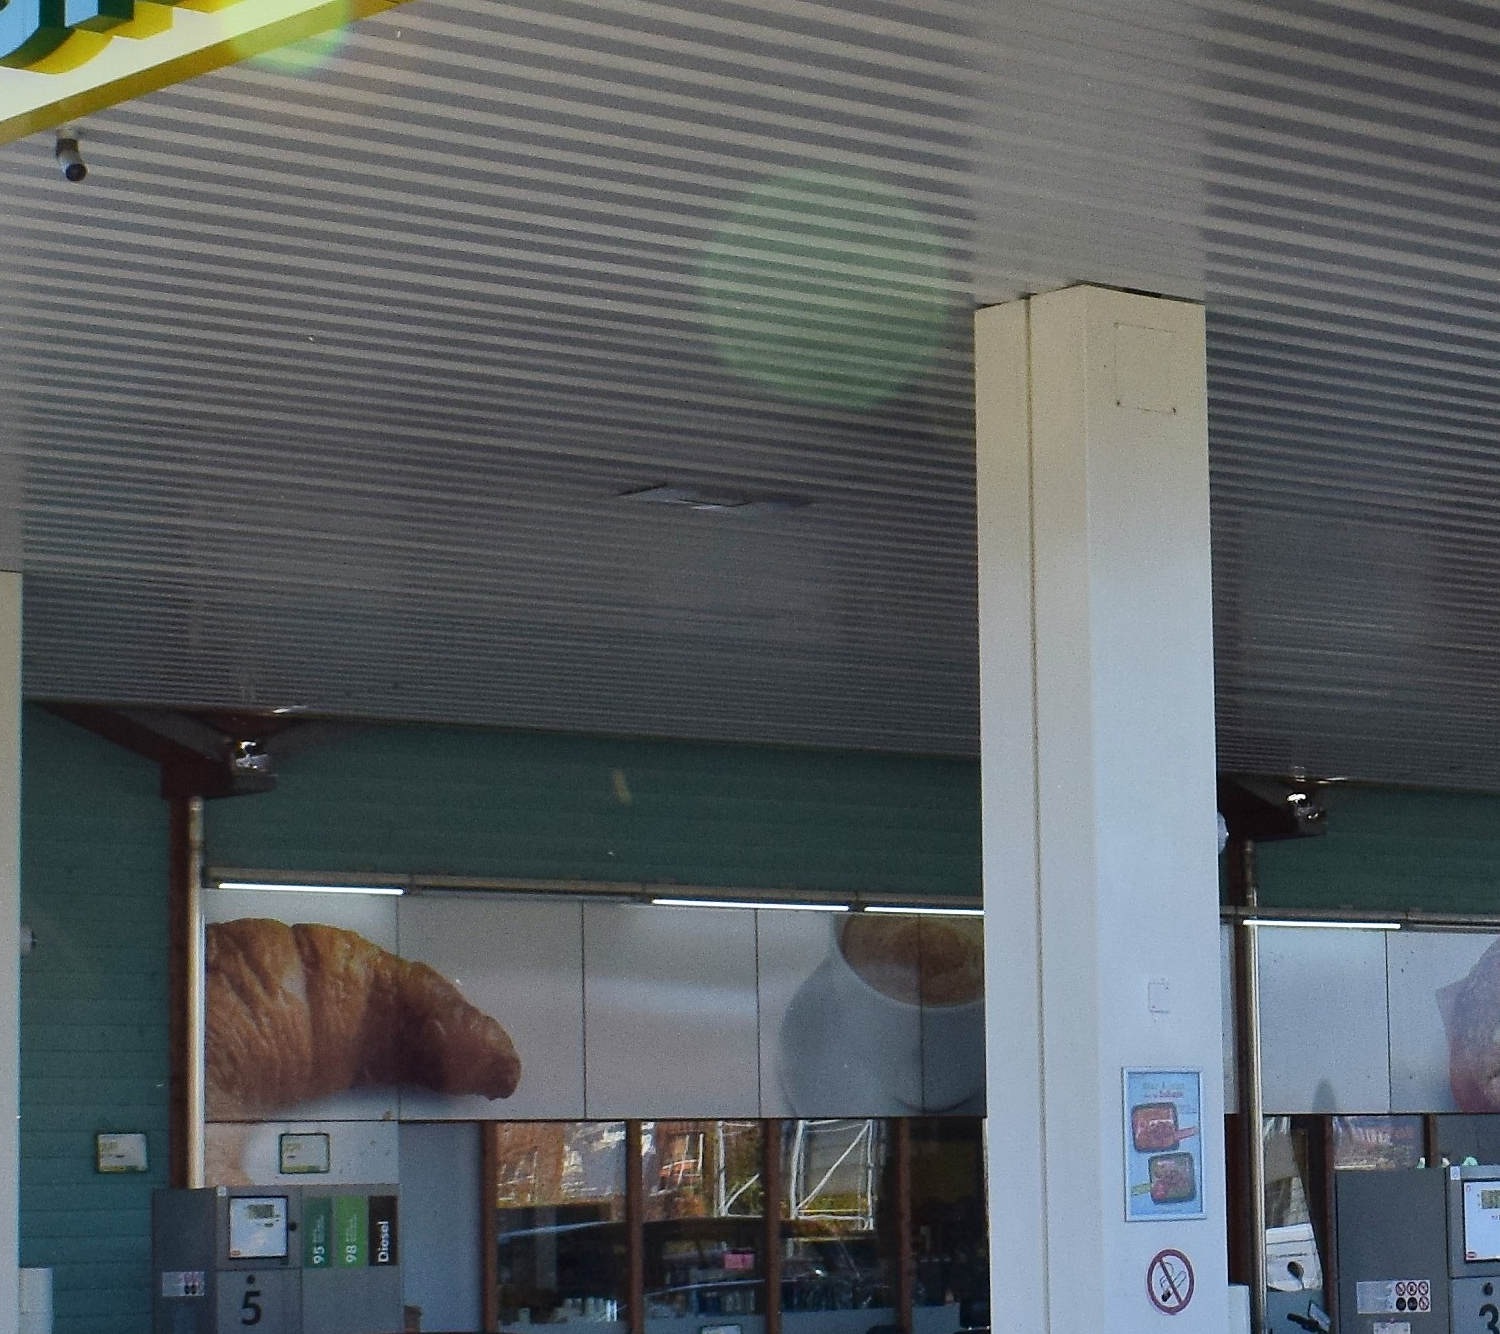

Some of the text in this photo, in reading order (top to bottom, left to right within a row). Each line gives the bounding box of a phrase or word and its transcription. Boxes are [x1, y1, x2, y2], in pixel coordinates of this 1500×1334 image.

[313, 1245, 325, 1265] 95
[346, 1244, 358, 1264] 98
[377, 1220, 390, 1264] Diesel
[241, 1290, 263, 1326] 5
